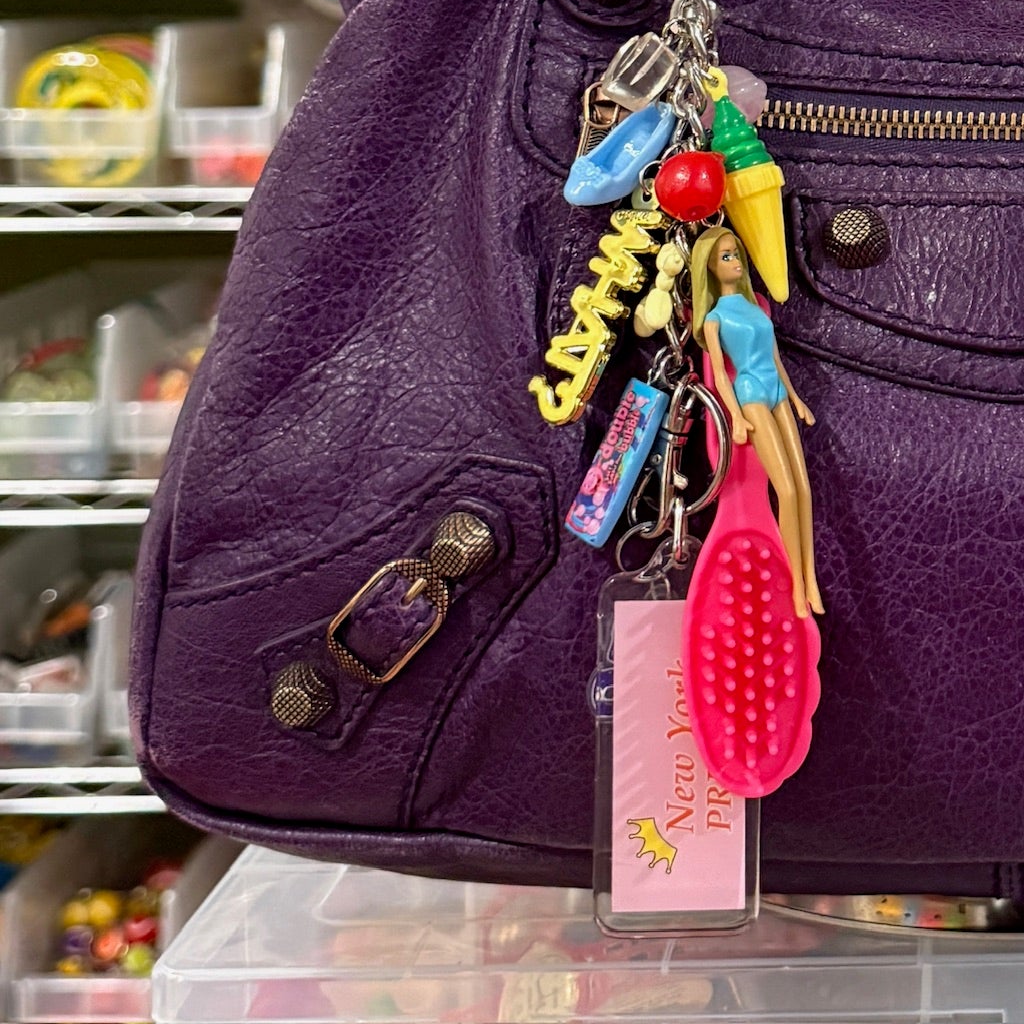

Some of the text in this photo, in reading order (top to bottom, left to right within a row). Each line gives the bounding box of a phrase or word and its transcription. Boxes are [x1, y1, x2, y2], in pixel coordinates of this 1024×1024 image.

[600, 391, 636, 459] double
[617, 409, 641, 453] bubble
[666, 753, 695, 833] New
[707, 773, 732, 831] PR
